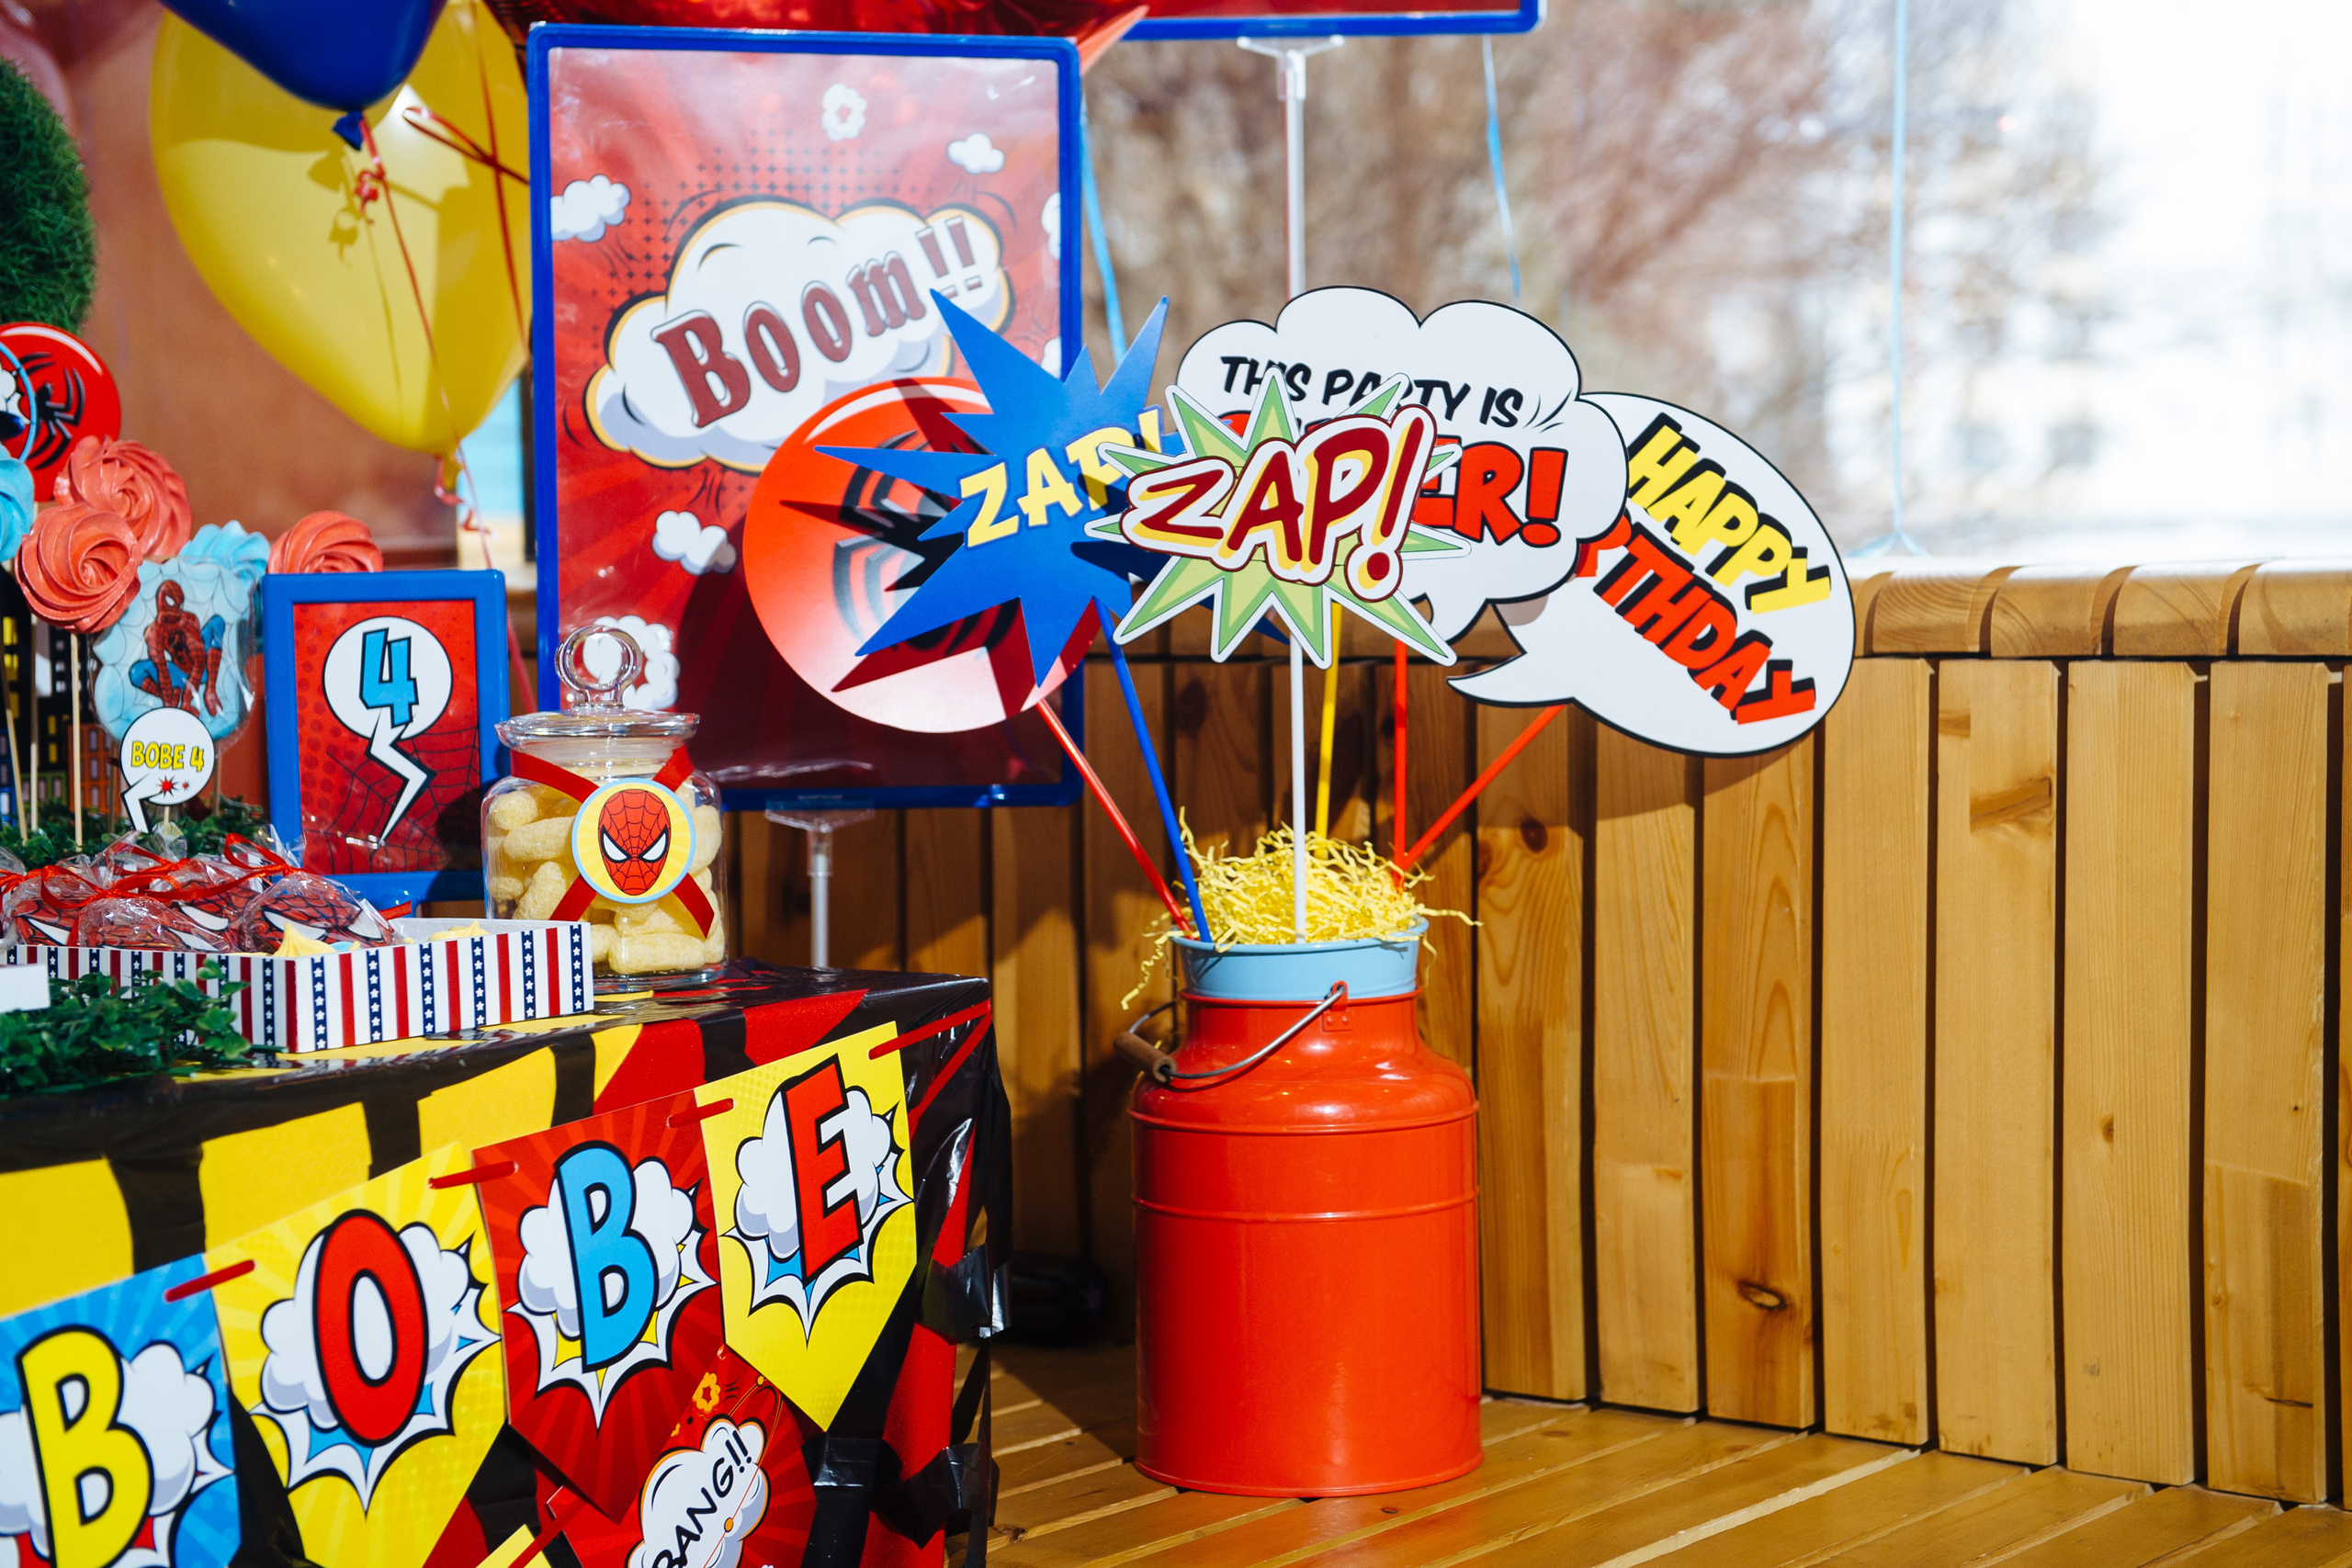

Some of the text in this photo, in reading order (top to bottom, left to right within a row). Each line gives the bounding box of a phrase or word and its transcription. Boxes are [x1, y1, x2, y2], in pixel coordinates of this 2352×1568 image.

[1220, 355, 1524, 429] THS PATY IS
[1130, 413, 1427, 592] ZAP!
[1627, 412, 1832, 615] HAPPY
[358, 626, 420, 728] 4
[130, 739, 205, 773] BOBE 4
